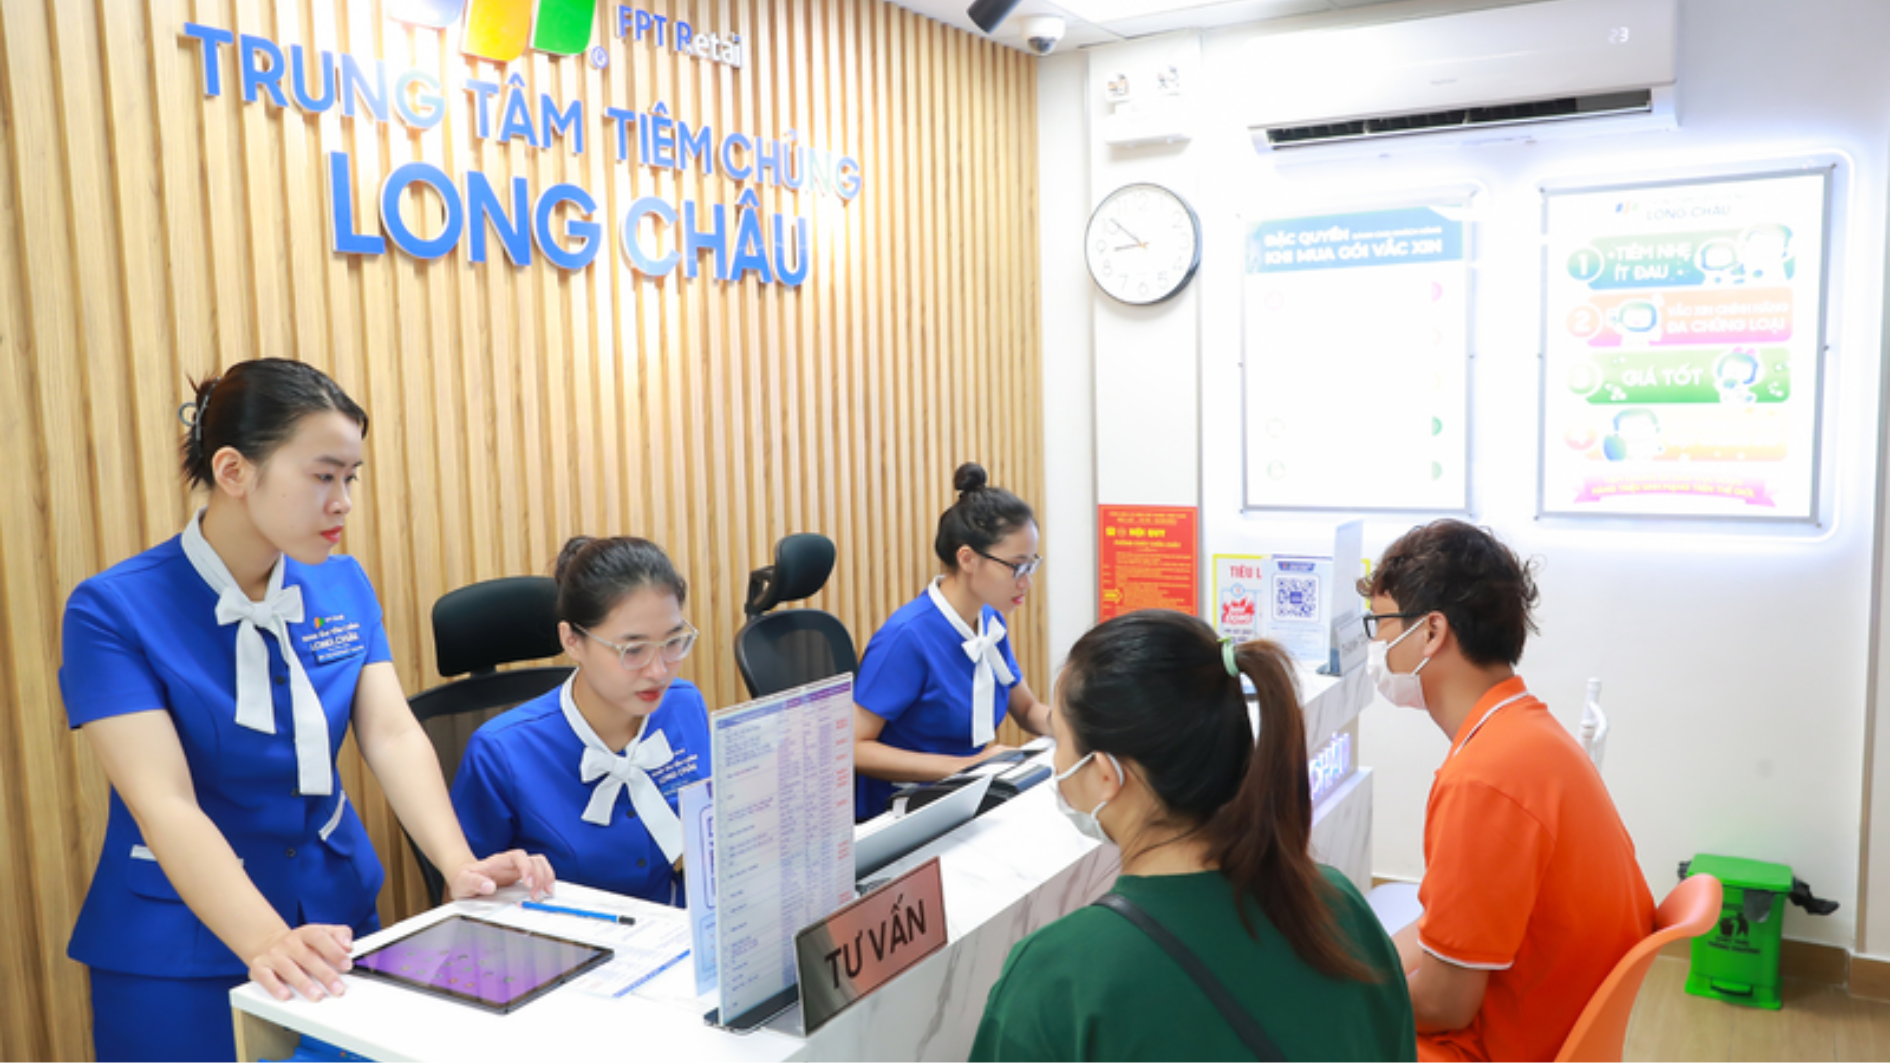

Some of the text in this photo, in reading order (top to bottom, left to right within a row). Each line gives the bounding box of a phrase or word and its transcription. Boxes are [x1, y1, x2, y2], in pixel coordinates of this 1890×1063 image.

[618, 5, 667, 47] FPT
[1608, 26, 1629, 44] 23
[184, 22, 862, 200] TRUNG TÂM TIÊM CHỦNG
[329, 151, 808, 286] LONG CHÂU
[1265, 250, 1293, 265] KHI
[1297, 246, 1335, 262] MUA
[1338, 241, 1369, 260] GÓI
[1411, 239, 1442, 254] XIN
[1616, 241, 1692, 262] TIÊM NHẸ
[1578, 254, 1588, 276] 1
[1574, 310, 1591, 333] 2
[1622, 362, 1704, 387] GIÁ TỐT
[823, 893, 927, 990] TƯ VẤN
